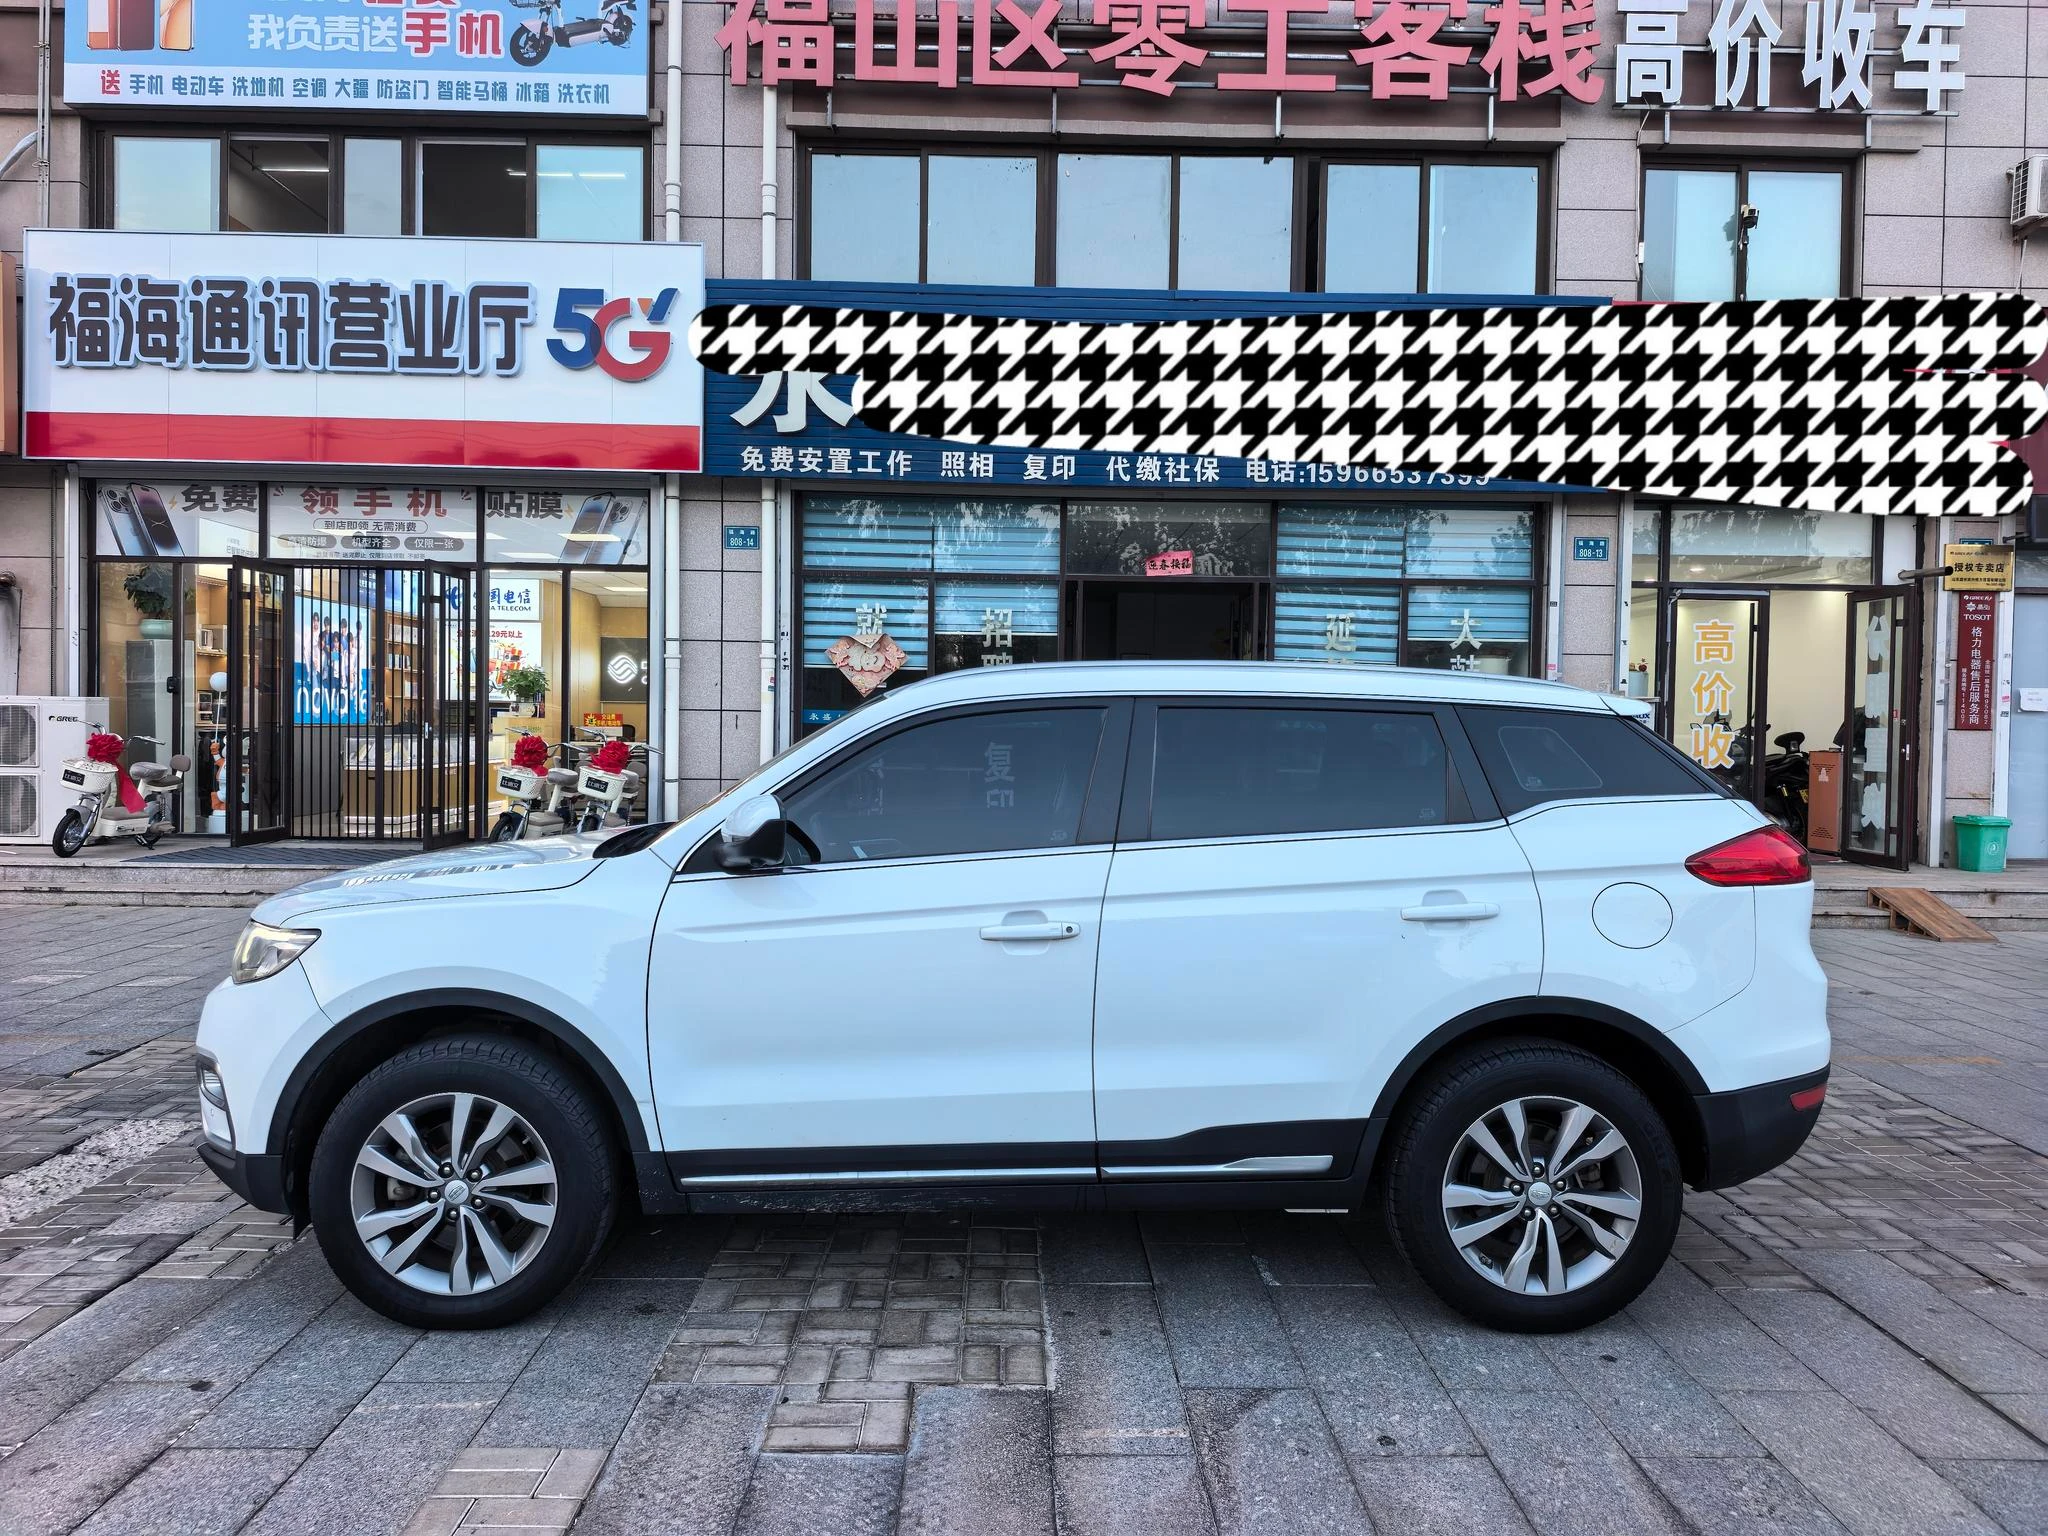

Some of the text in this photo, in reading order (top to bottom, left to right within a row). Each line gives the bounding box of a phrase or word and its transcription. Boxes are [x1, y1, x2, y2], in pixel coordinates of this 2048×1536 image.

[248, 12, 502, 57] 我负责送手机
[714, 0, 1605, 103] 福山区零工客栈
[1614, 0, 1967, 112] 高价收车
[101, 69, 610, 104] 送 手机 电动车 洗地机 空调 大疆 防盗门 智能马桶 冰箱 洗衣机
[49, 276, 532, 374] 福海通讯营业厅
[546, 288, 679, 382] 5G
[741, 446, 912, 477] 免费安置工作
[941, 451, 994, 478] 照相
[1023, 454, 1076, 480] 复印
[1106, 456, 1220, 483] 代缴社保
[181, 484, 563, 518] 免费 领手机 贴膜
[324, 521, 416, 532] 到店即领 无需消费
[415, 539, 454, 549] 仅限一张
[730, 538, 754, 546] 808-14
[1580, 548, 1602, 558] 808-13
[1954, 562, 2005, 573] 授权专卖店
[1968, 626, 1983, 725] 格力电器售后服务商
[1691, 620, 1735, 769] 高价收
[809, 712, 841, 721] 永盛
